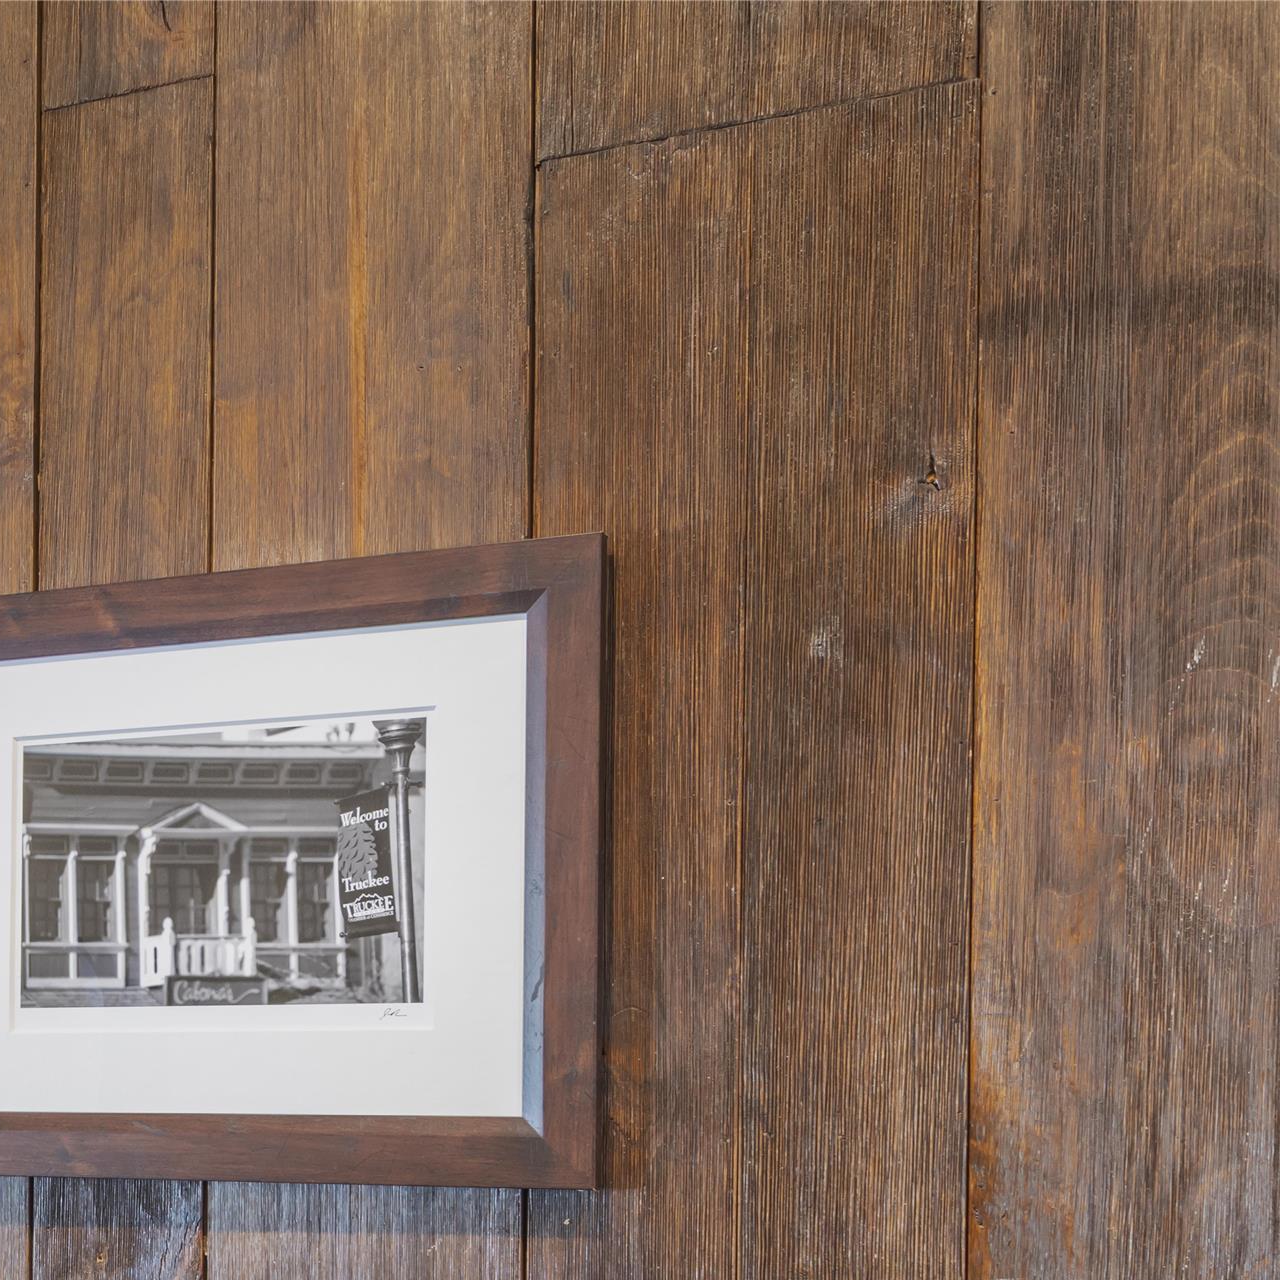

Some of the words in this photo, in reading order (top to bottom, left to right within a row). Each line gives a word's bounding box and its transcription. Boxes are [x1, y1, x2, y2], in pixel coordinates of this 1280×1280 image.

[340, 806, 389, 827] Welcome
[374, 820, 388, 832] to
[342, 871, 390, 893] Truckee
[343, 895, 394, 918] TRUCKEE
